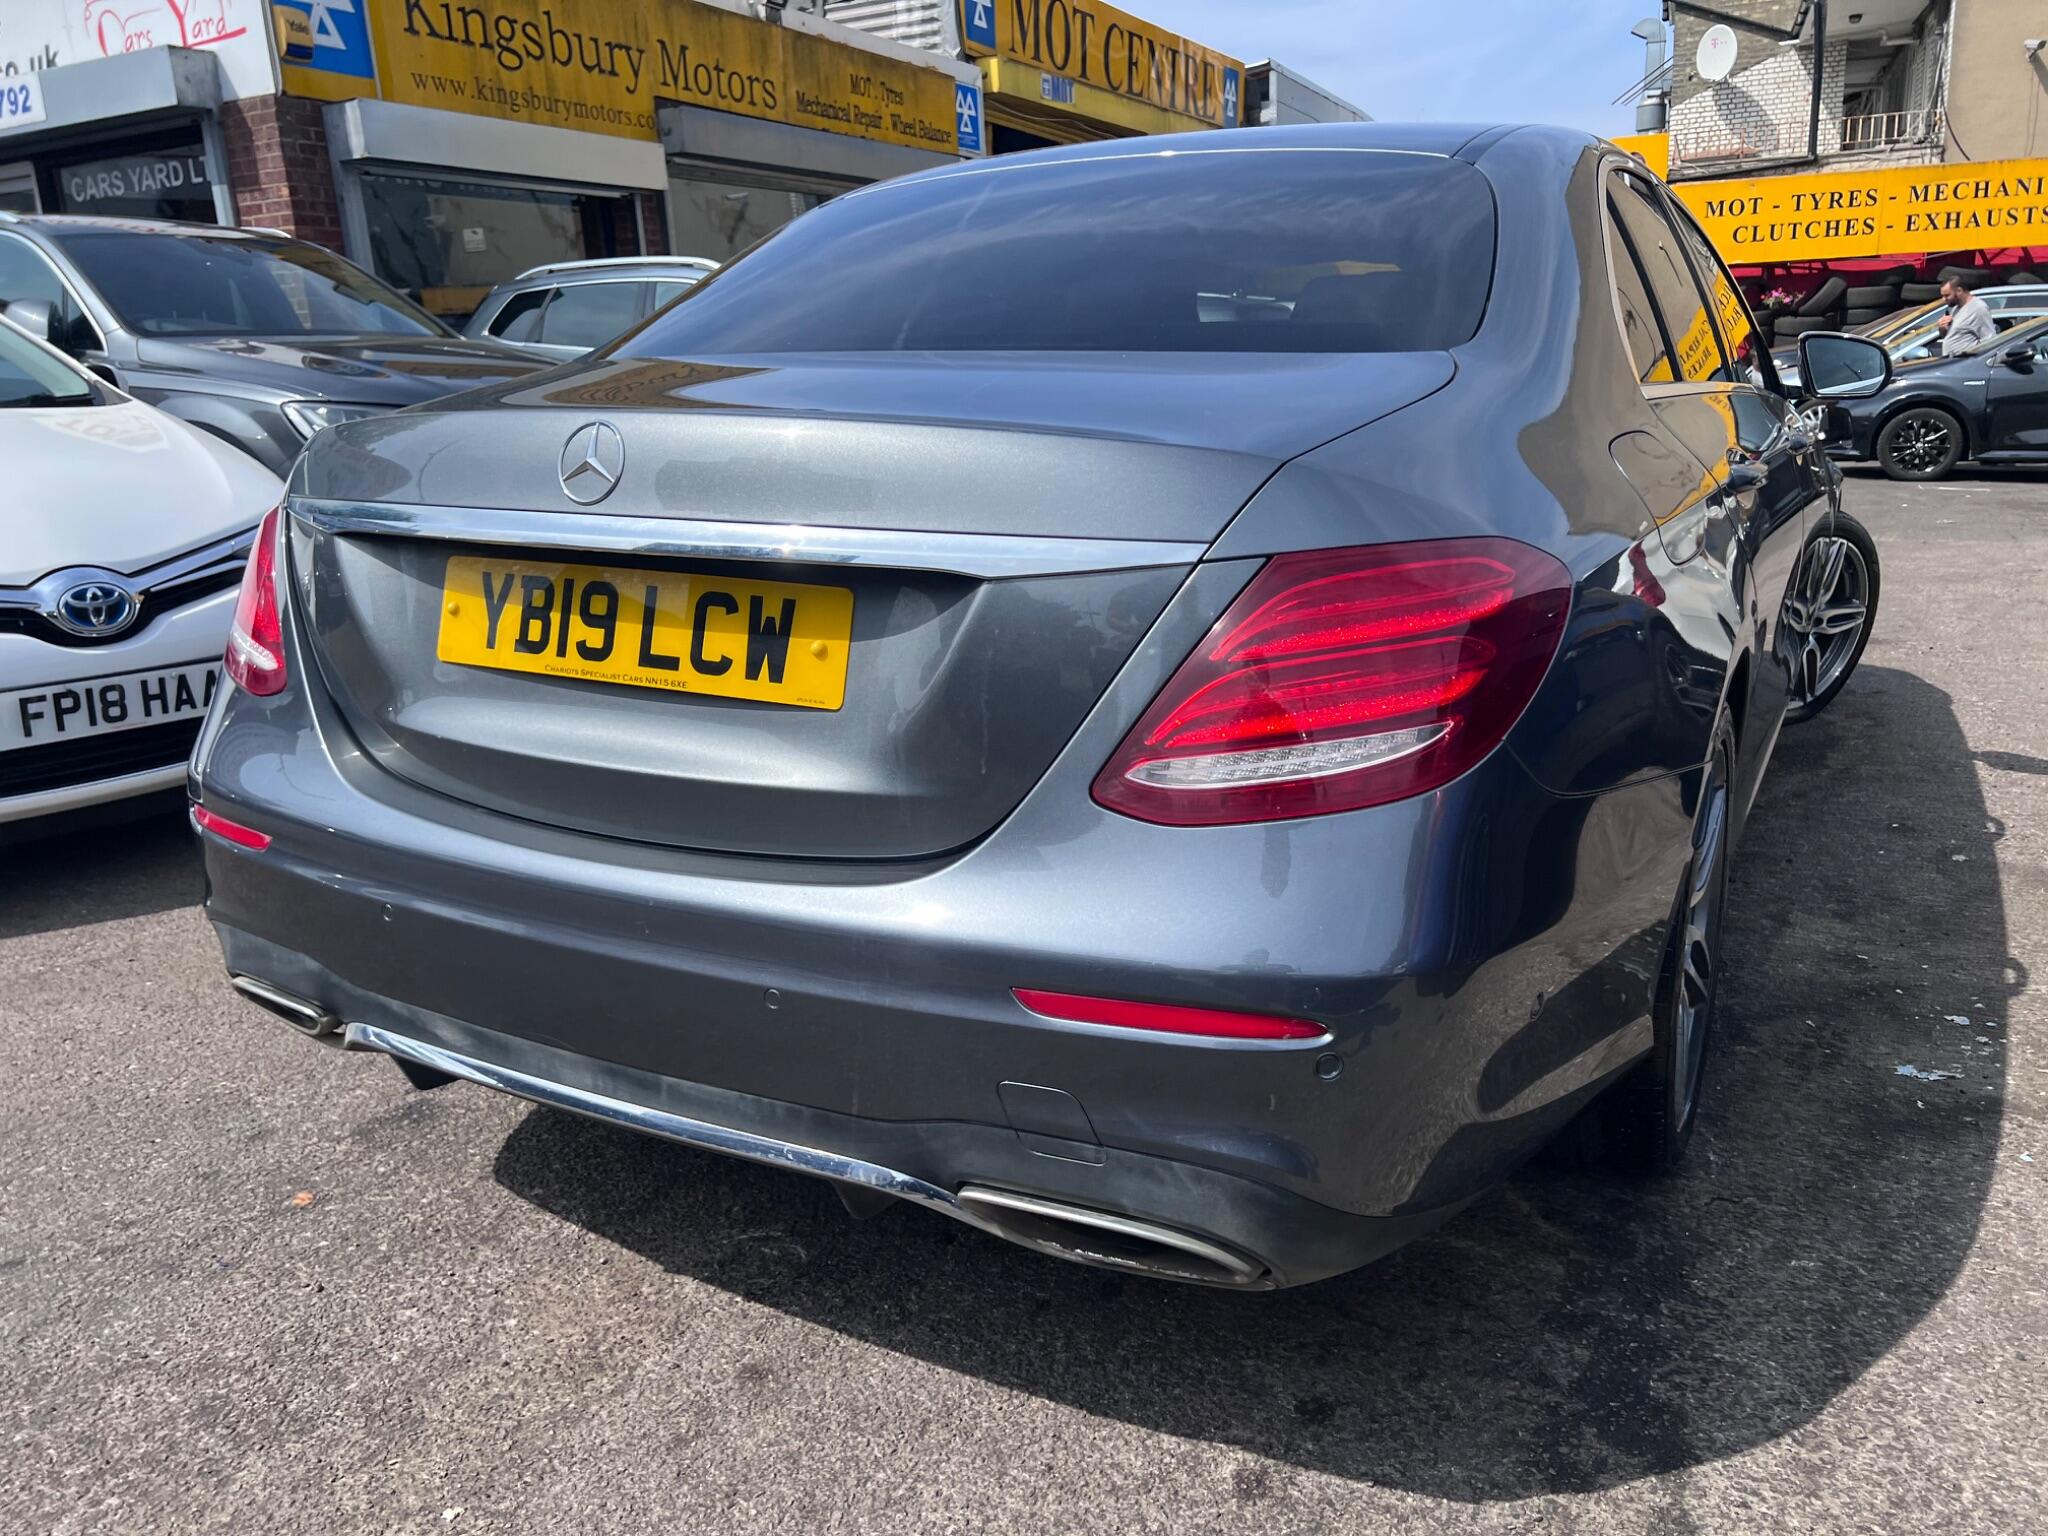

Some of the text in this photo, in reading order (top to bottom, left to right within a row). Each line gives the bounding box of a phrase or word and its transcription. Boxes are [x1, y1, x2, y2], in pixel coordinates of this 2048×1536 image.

[403, 0, 777, 111] Kingsbury Motors
[1008, 0, 1216, 120] MOT CENTRE
[796, 90, 851, 123] Mechanical
[853, 104, 882, 132] Repair
[890, 112, 916, 135] Wheel
[919, 119, 952, 144] Balance
[850, 73, 904, 108] MOT Tyres
[71, 170, 125, 202] CARS
[128, 161, 184, 192] YARD
[1705, 197, 1763, 218] MOT
[1792, 188, 1877, 211] TYRES
[1908, 176, 2045, 203] MECHANI
[1732, 217, 1875, 243] CLUTCHES
[482, 571, 797, 684] YB19 LCW
[19, 684, 128, 738] FP18
